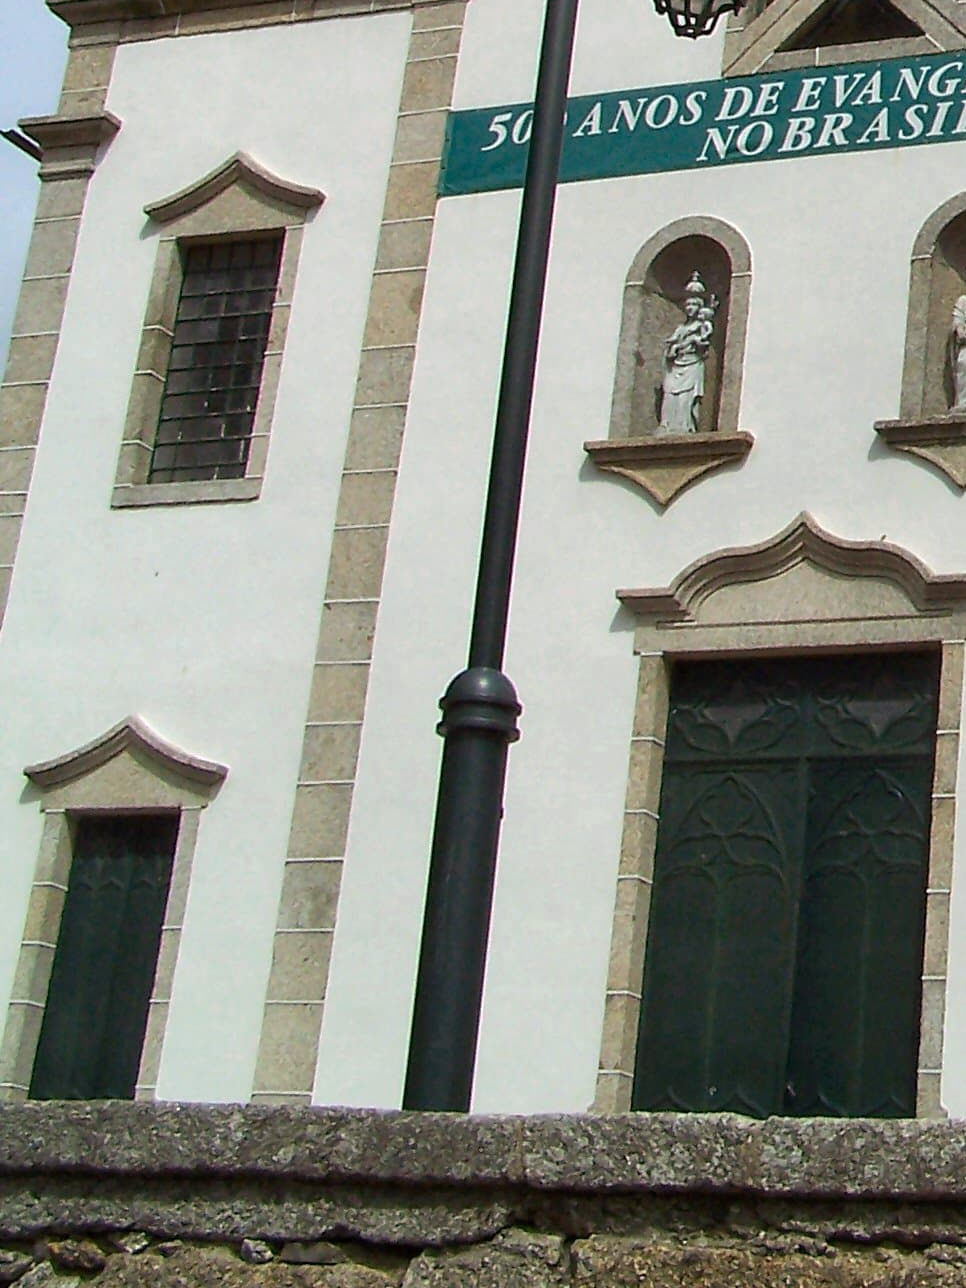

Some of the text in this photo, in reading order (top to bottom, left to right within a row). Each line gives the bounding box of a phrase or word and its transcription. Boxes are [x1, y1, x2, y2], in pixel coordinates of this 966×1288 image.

[481, 109, 568, 151] 50
[572, 91, 706, 137] ANOS
[715, 81, 785, 121] DE
[696, 120, 774, 161] NO
